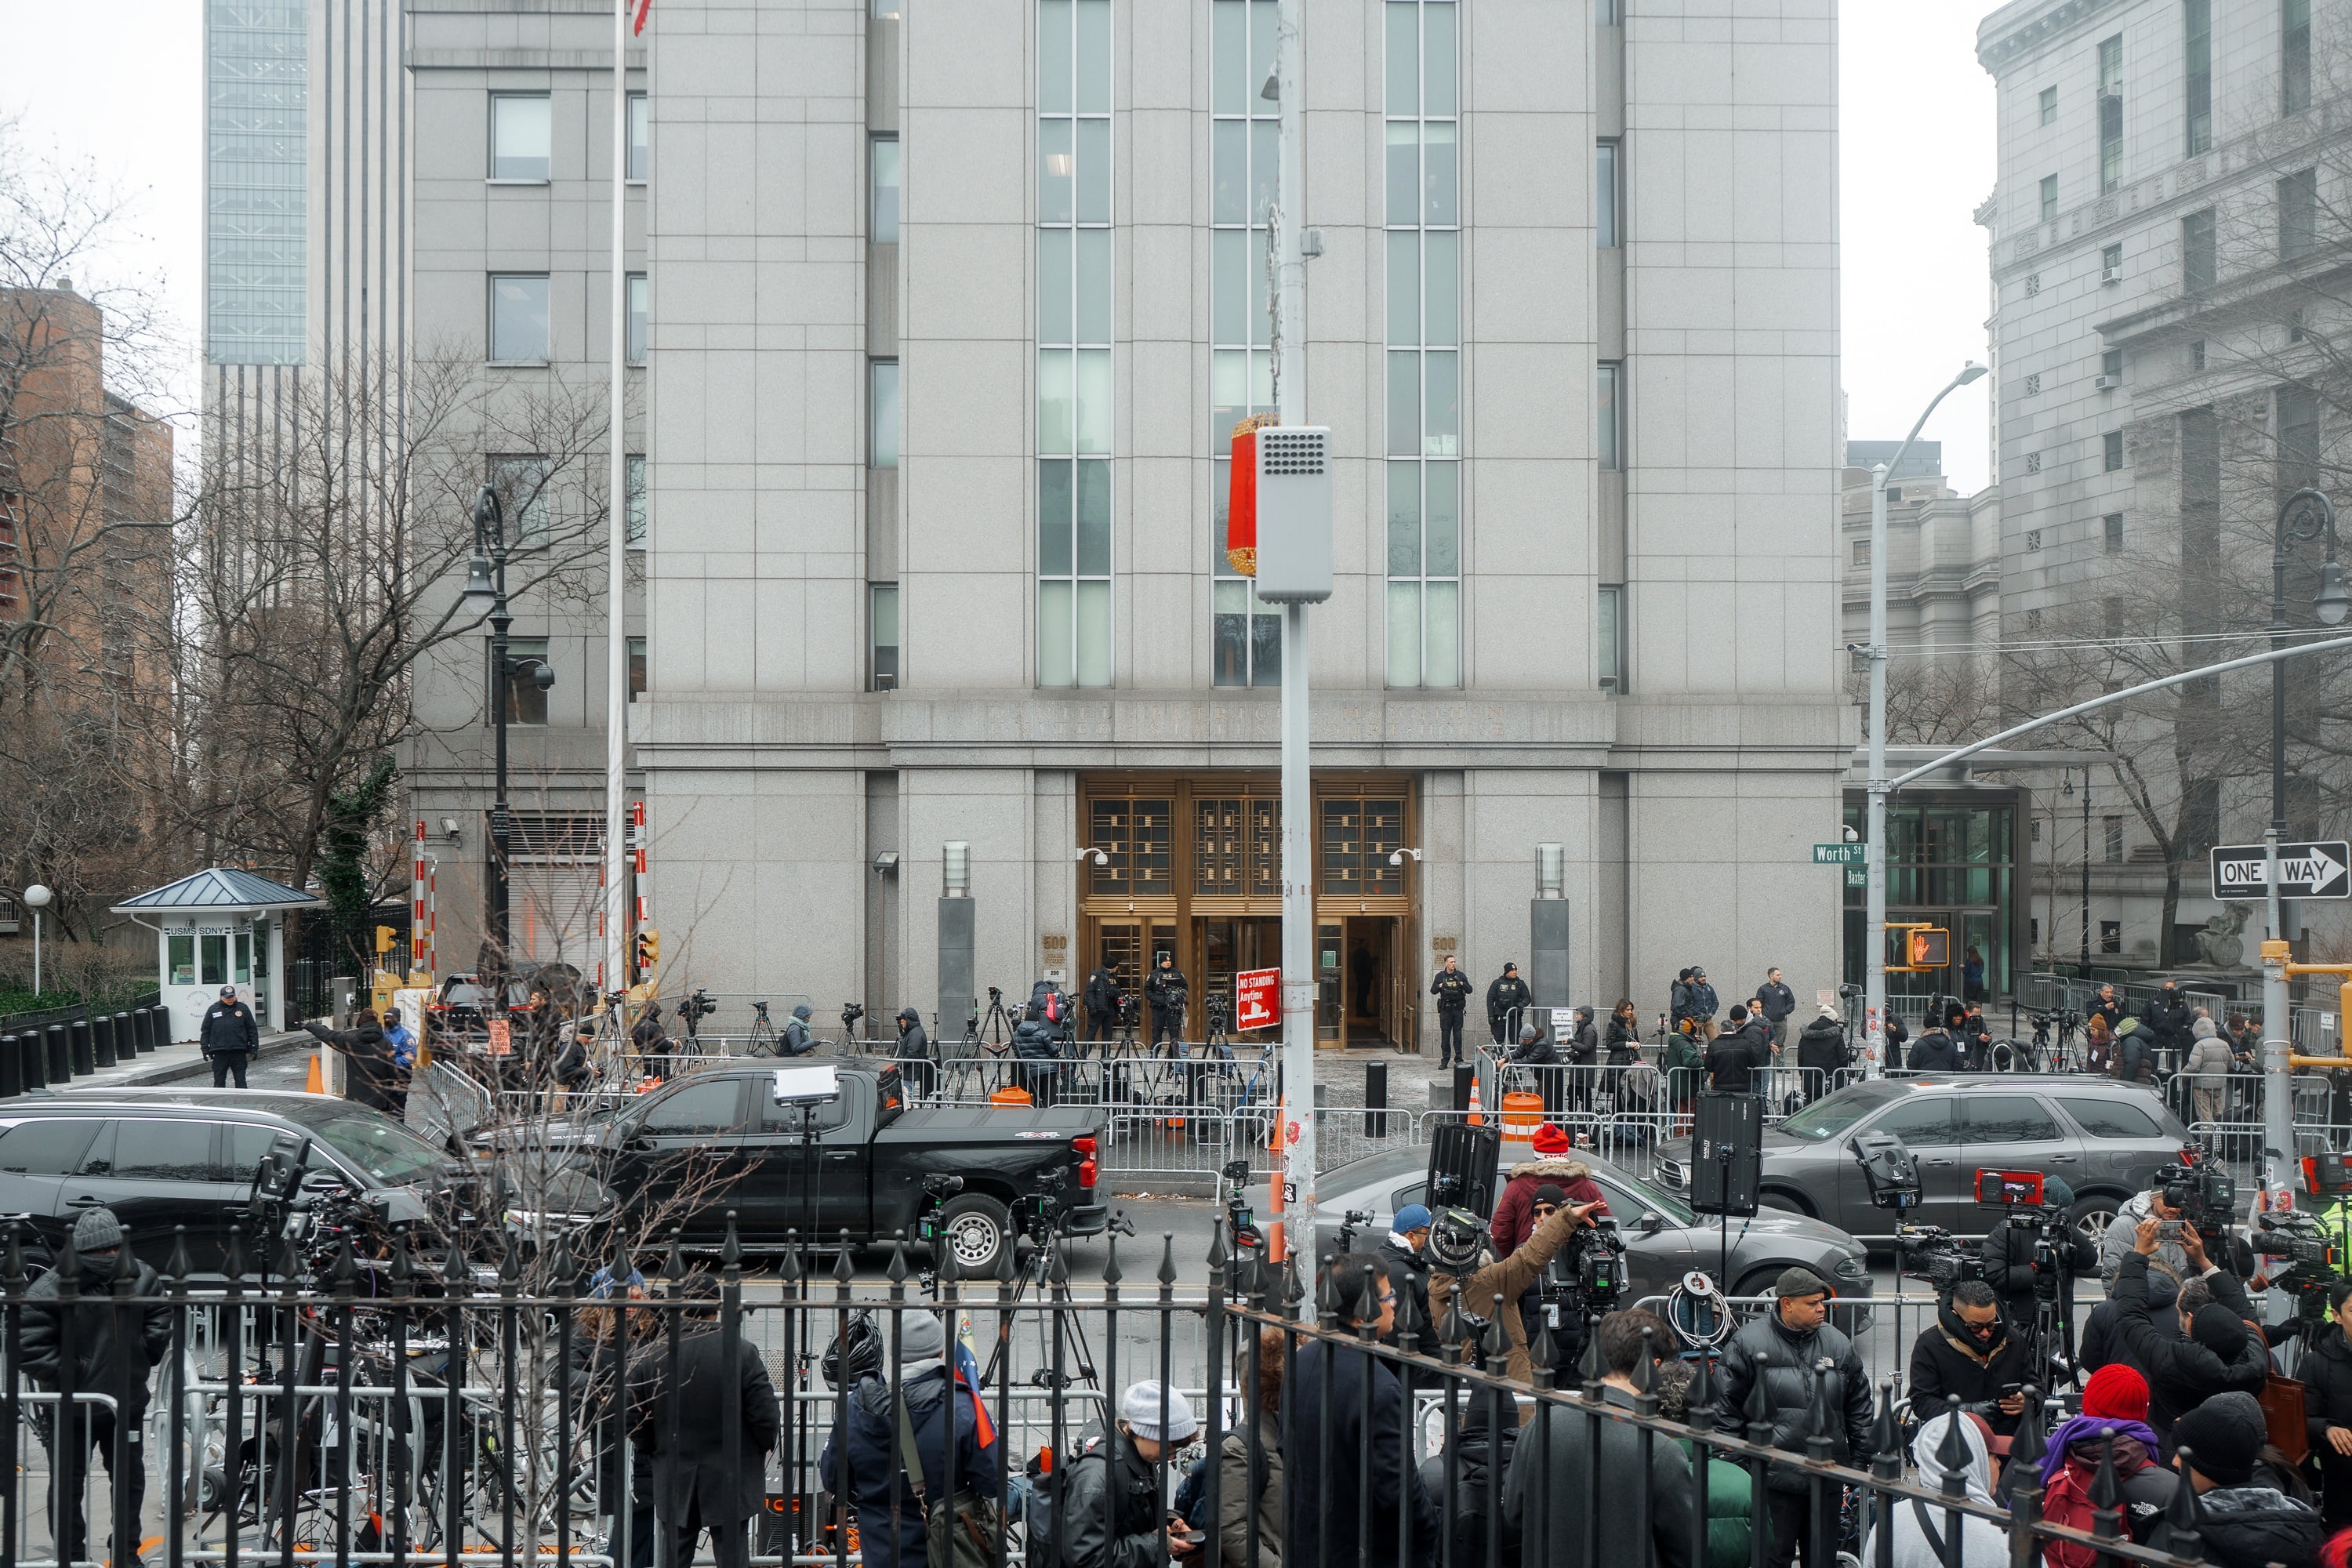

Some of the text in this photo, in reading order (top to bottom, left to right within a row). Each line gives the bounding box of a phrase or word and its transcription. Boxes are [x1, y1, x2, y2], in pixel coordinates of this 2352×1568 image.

[990, 706, 1112, 719] DANIEL
[1343, 706, 1503, 720] MOYNIHAN
[990, 722, 1112, 735] UNITED
[1150, 722, 1267, 735] STATES
[1420, 723, 1505, 736] HOUSE
[1817, 845, 1861, 861] Worth St
[1848, 869, 1866, 885] Baxter
[2224, 860, 2328, 883] ONE WAY
[1044, 935, 1067, 949] 500
[1432, 937, 1456, 949] 500
[1240, 975, 1275, 989] NO STANDING
[1240, 990, 1263, 1004] Anytime
[2131, 1503, 2151, 1512] NORTH
